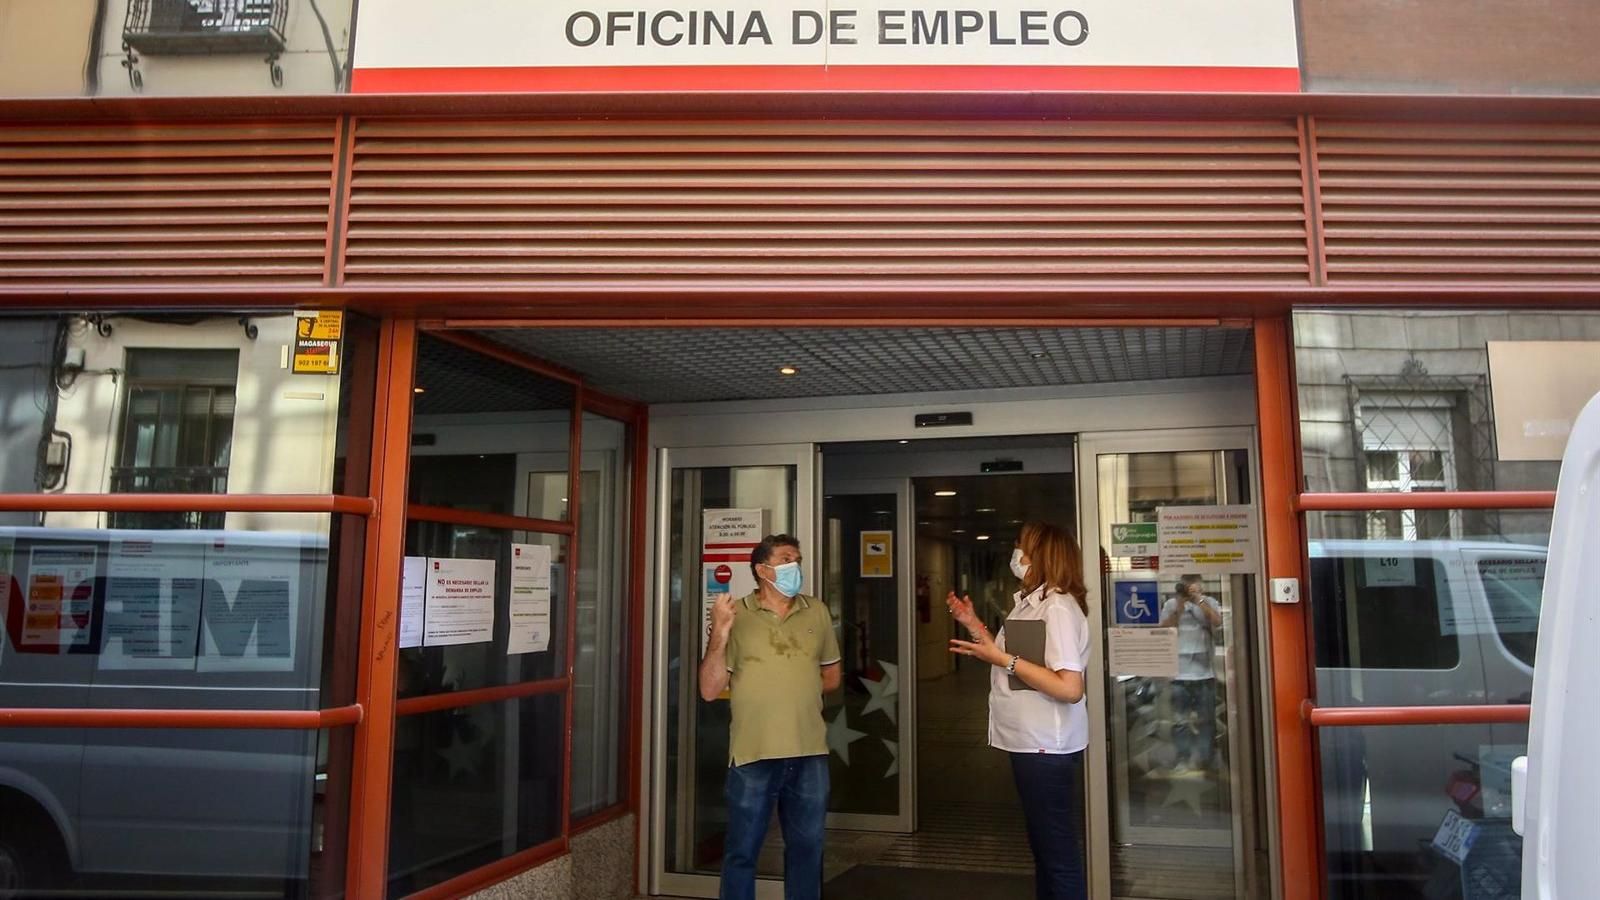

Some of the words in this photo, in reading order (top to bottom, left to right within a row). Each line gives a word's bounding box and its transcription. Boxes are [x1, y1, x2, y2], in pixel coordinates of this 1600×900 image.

[564, 10, 773, 46] OFICINA
[791, 10, 858, 45] DE
[878, 10, 1090, 46] EMPLEO
